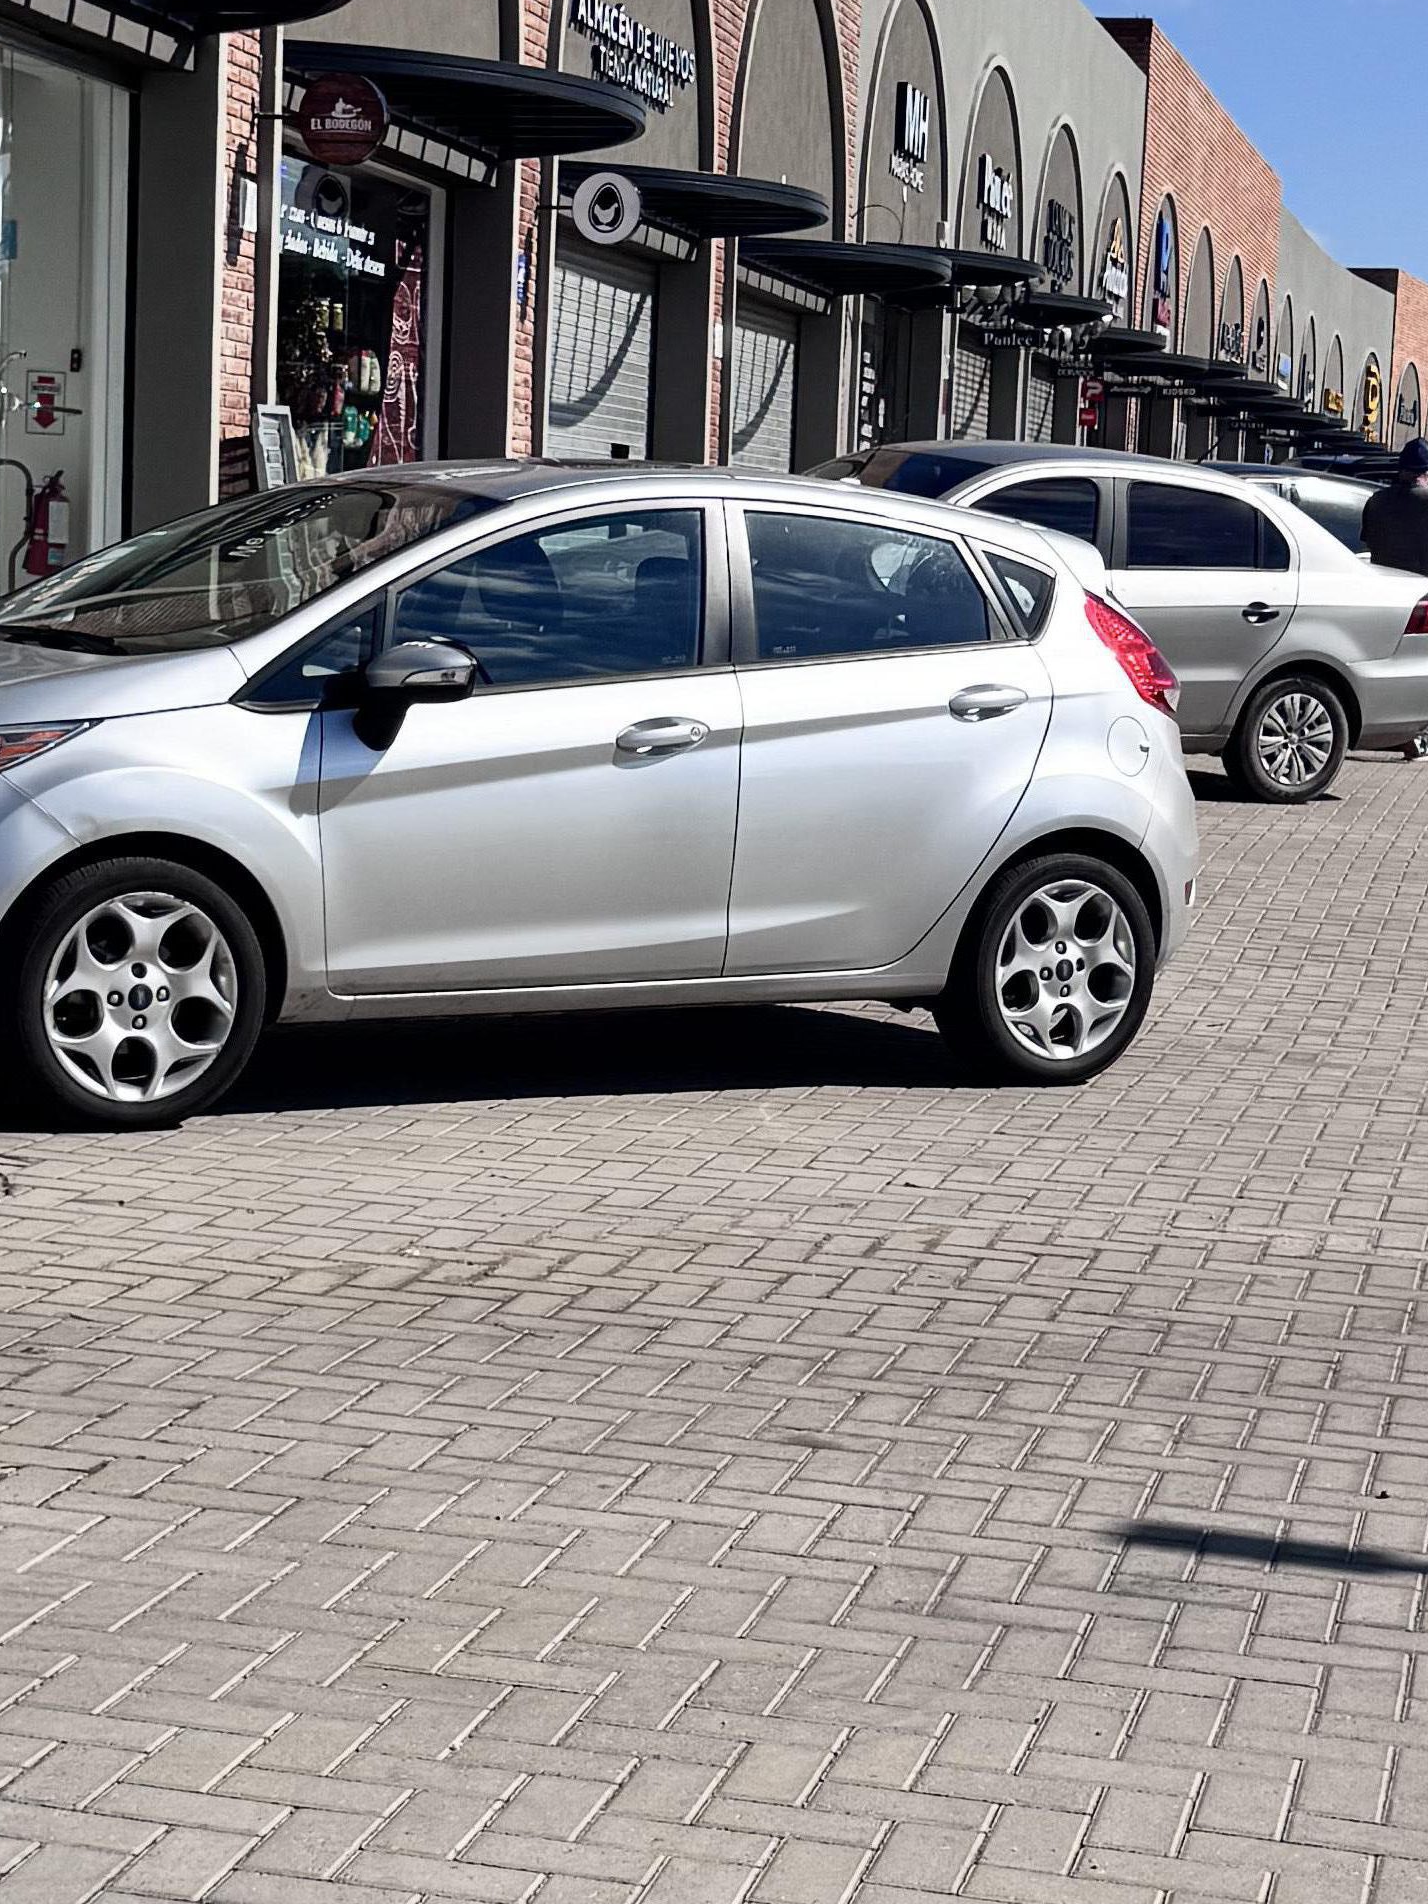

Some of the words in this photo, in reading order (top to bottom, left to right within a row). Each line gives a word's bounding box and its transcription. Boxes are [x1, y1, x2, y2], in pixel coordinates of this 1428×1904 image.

[636, 23, 652, 59] DE
[654, 32, 697, 83] HUEVOS
[310, 117, 322, 131] EL
[904, 82, 930, 163] MH
